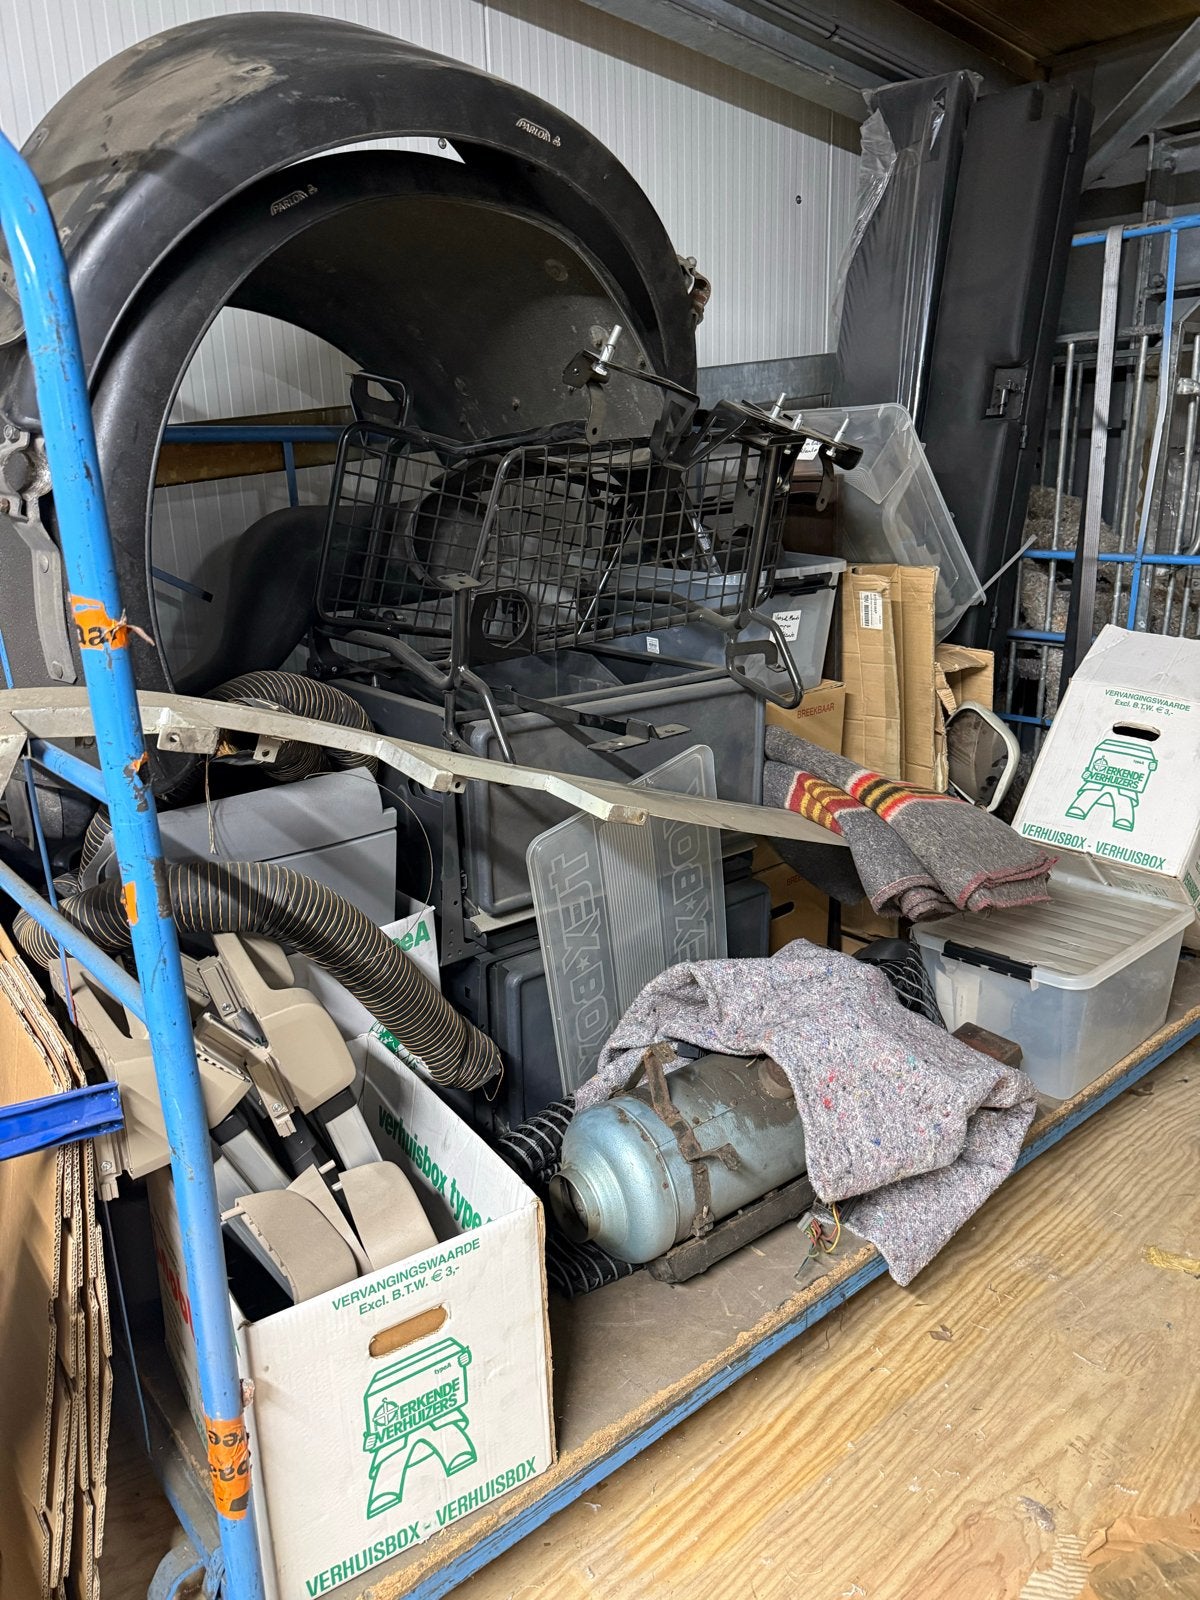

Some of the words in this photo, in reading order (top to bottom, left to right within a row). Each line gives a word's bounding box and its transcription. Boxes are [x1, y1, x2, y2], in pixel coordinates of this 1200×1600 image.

[797, 702, 835, 719] BREEKBAAR
[1105, 689, 1191, 712] VERVANGINGSWAARDE
[1114, 698, 1131, 707] Excl.
[1132, 702, 1154, 712] B.T.W.
[1090, 771, 1139, 789] VERHUIZERS
[1106, 766, 1145, 782] ERKENDE
[1021, 822, 1088, 850] VERHUISBOX
[1095, 840, 1167, 871] VERHUISBOX
[378, 1104, 448, 1199] verhuisbox
[332, 1237, 481, 1311] VERVANGINGSWAARDE
[358, 1294, 390, 1316] Excl.
[391, 1276, 429, 1301] B.T.W.
[431, 1268, 444, 1282] €
[445, 1265, 460, 1278] 3,-
[376, 1393, 458, 1444] VERHUIZERS
[400, 1376, 460, 1420] ERKENDE
[305, 1520, 421, 1598] VERHUISBOX
[435, 1455, 538, 1527] VERHUISBOX
